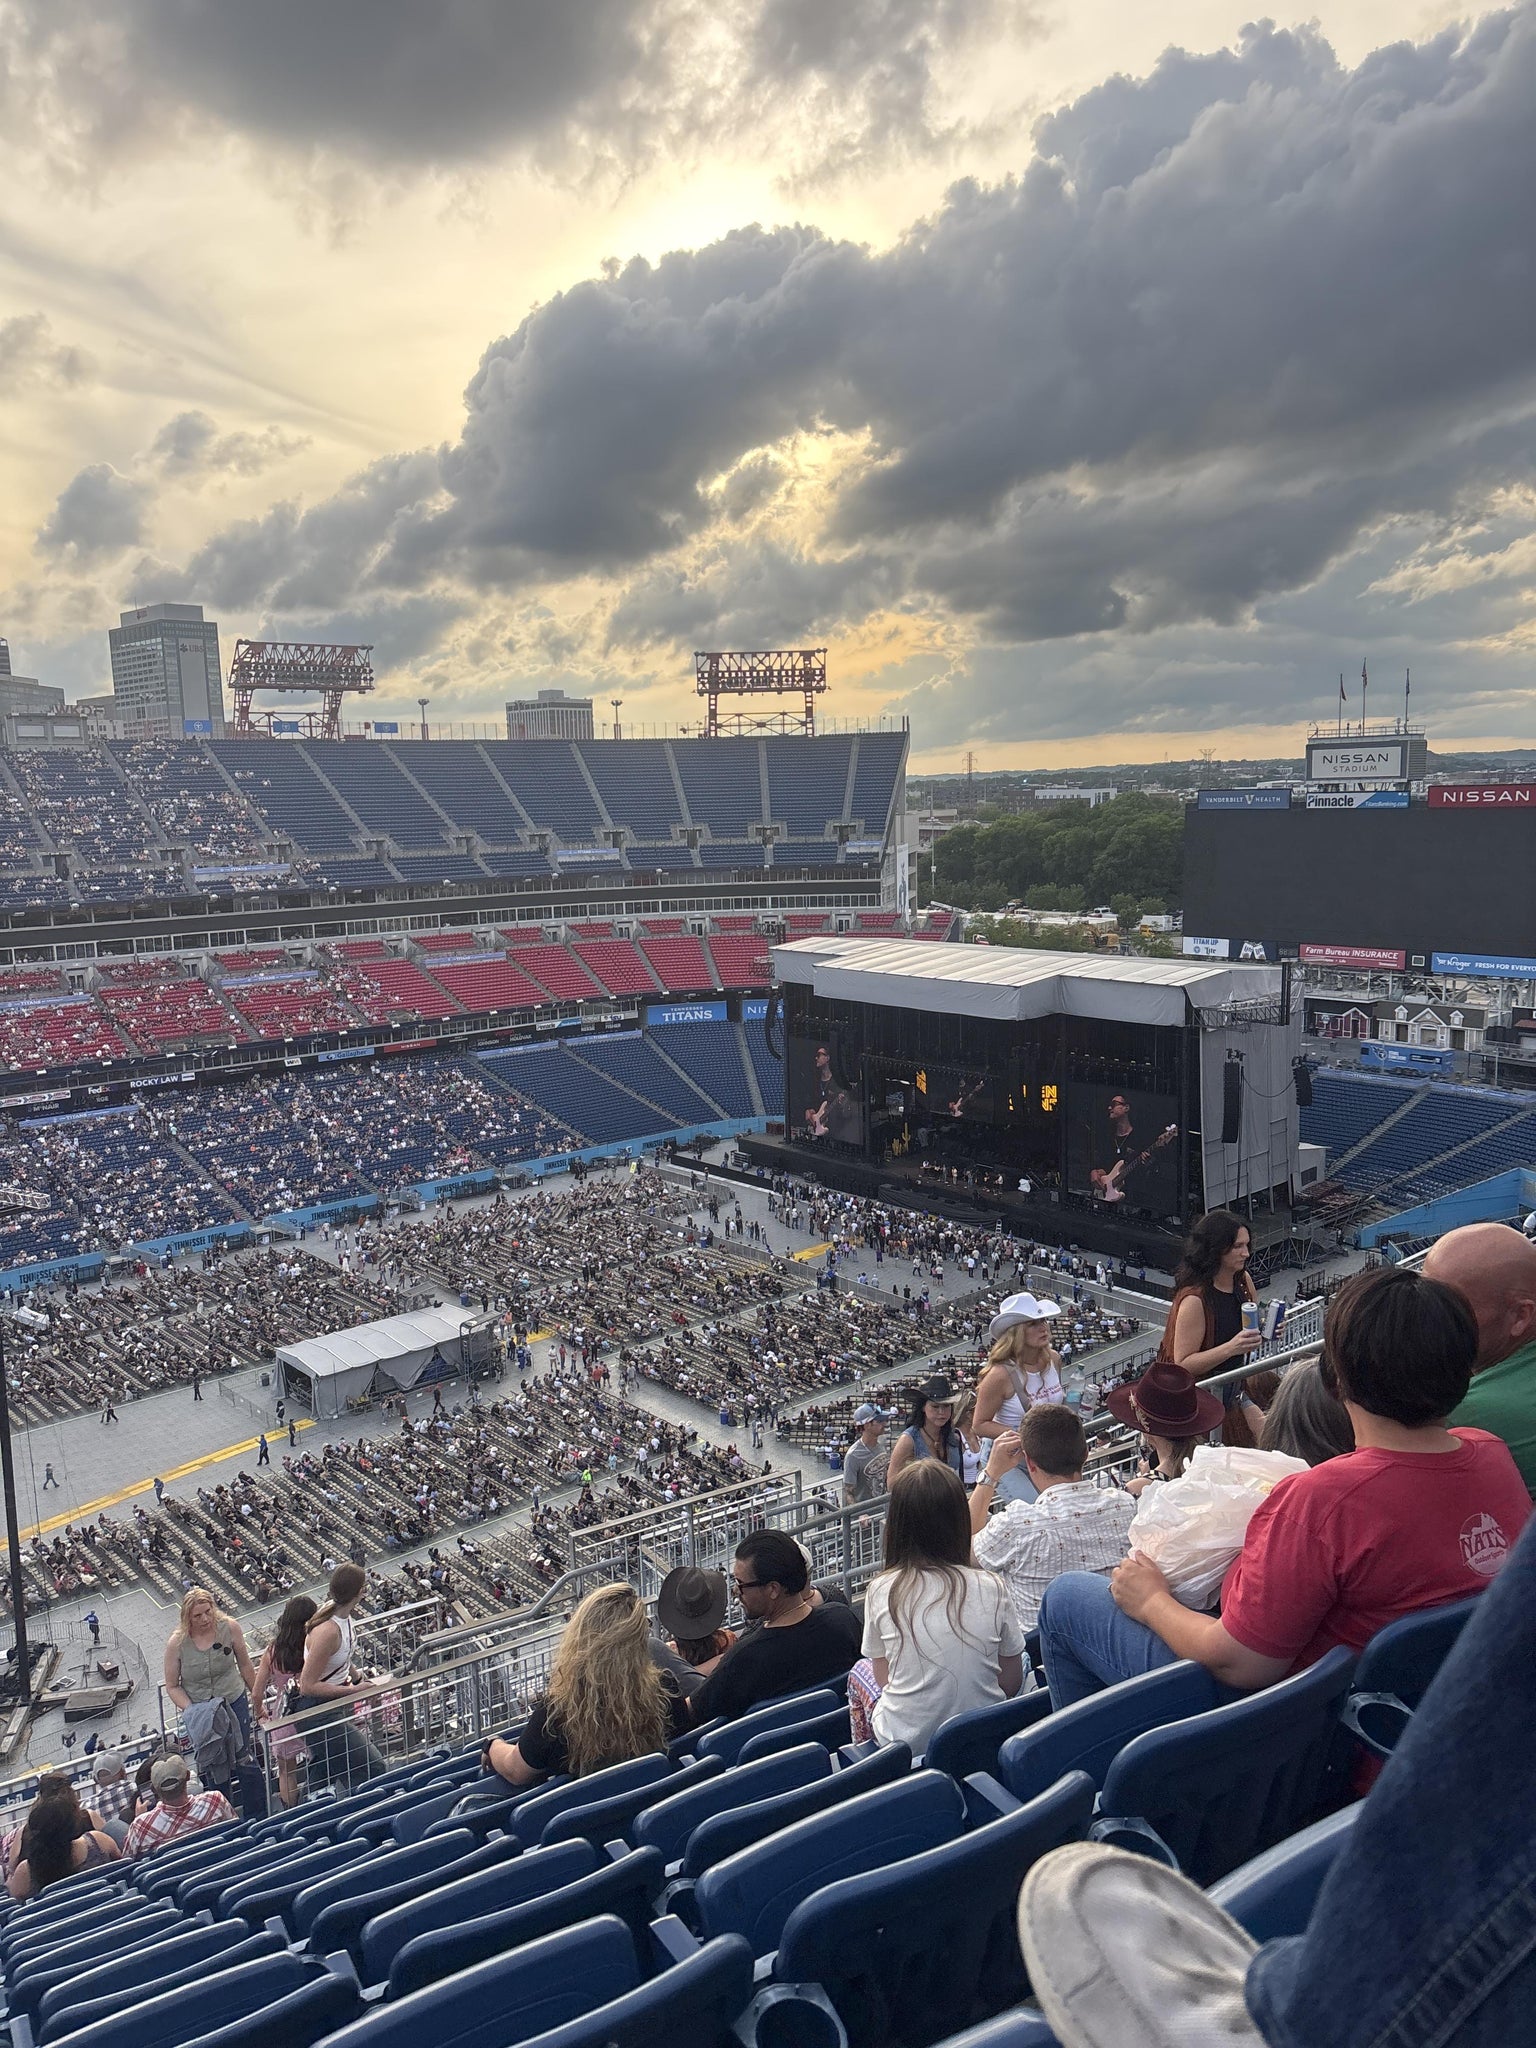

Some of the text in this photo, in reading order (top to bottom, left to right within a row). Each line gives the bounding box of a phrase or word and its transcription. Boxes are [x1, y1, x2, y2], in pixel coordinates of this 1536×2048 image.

[1322, 752, 1389, 764] NISSAN
[1333, 764, 1378, 773] STADIUM
[1307, 795, 1354, 807] Pinnacle
[1443, 790, 1530, 802] NISSAN
[1305, 946, 1399, 960] Farm Bureau INSURANCE
[1447, 957, 1471, 971] Kroger
[662, 1010, 713, 1022] TITANS
[130, 1074, 179, 1089] ROCKY LAW
[88, 1086, 111, 1095] FedEx
